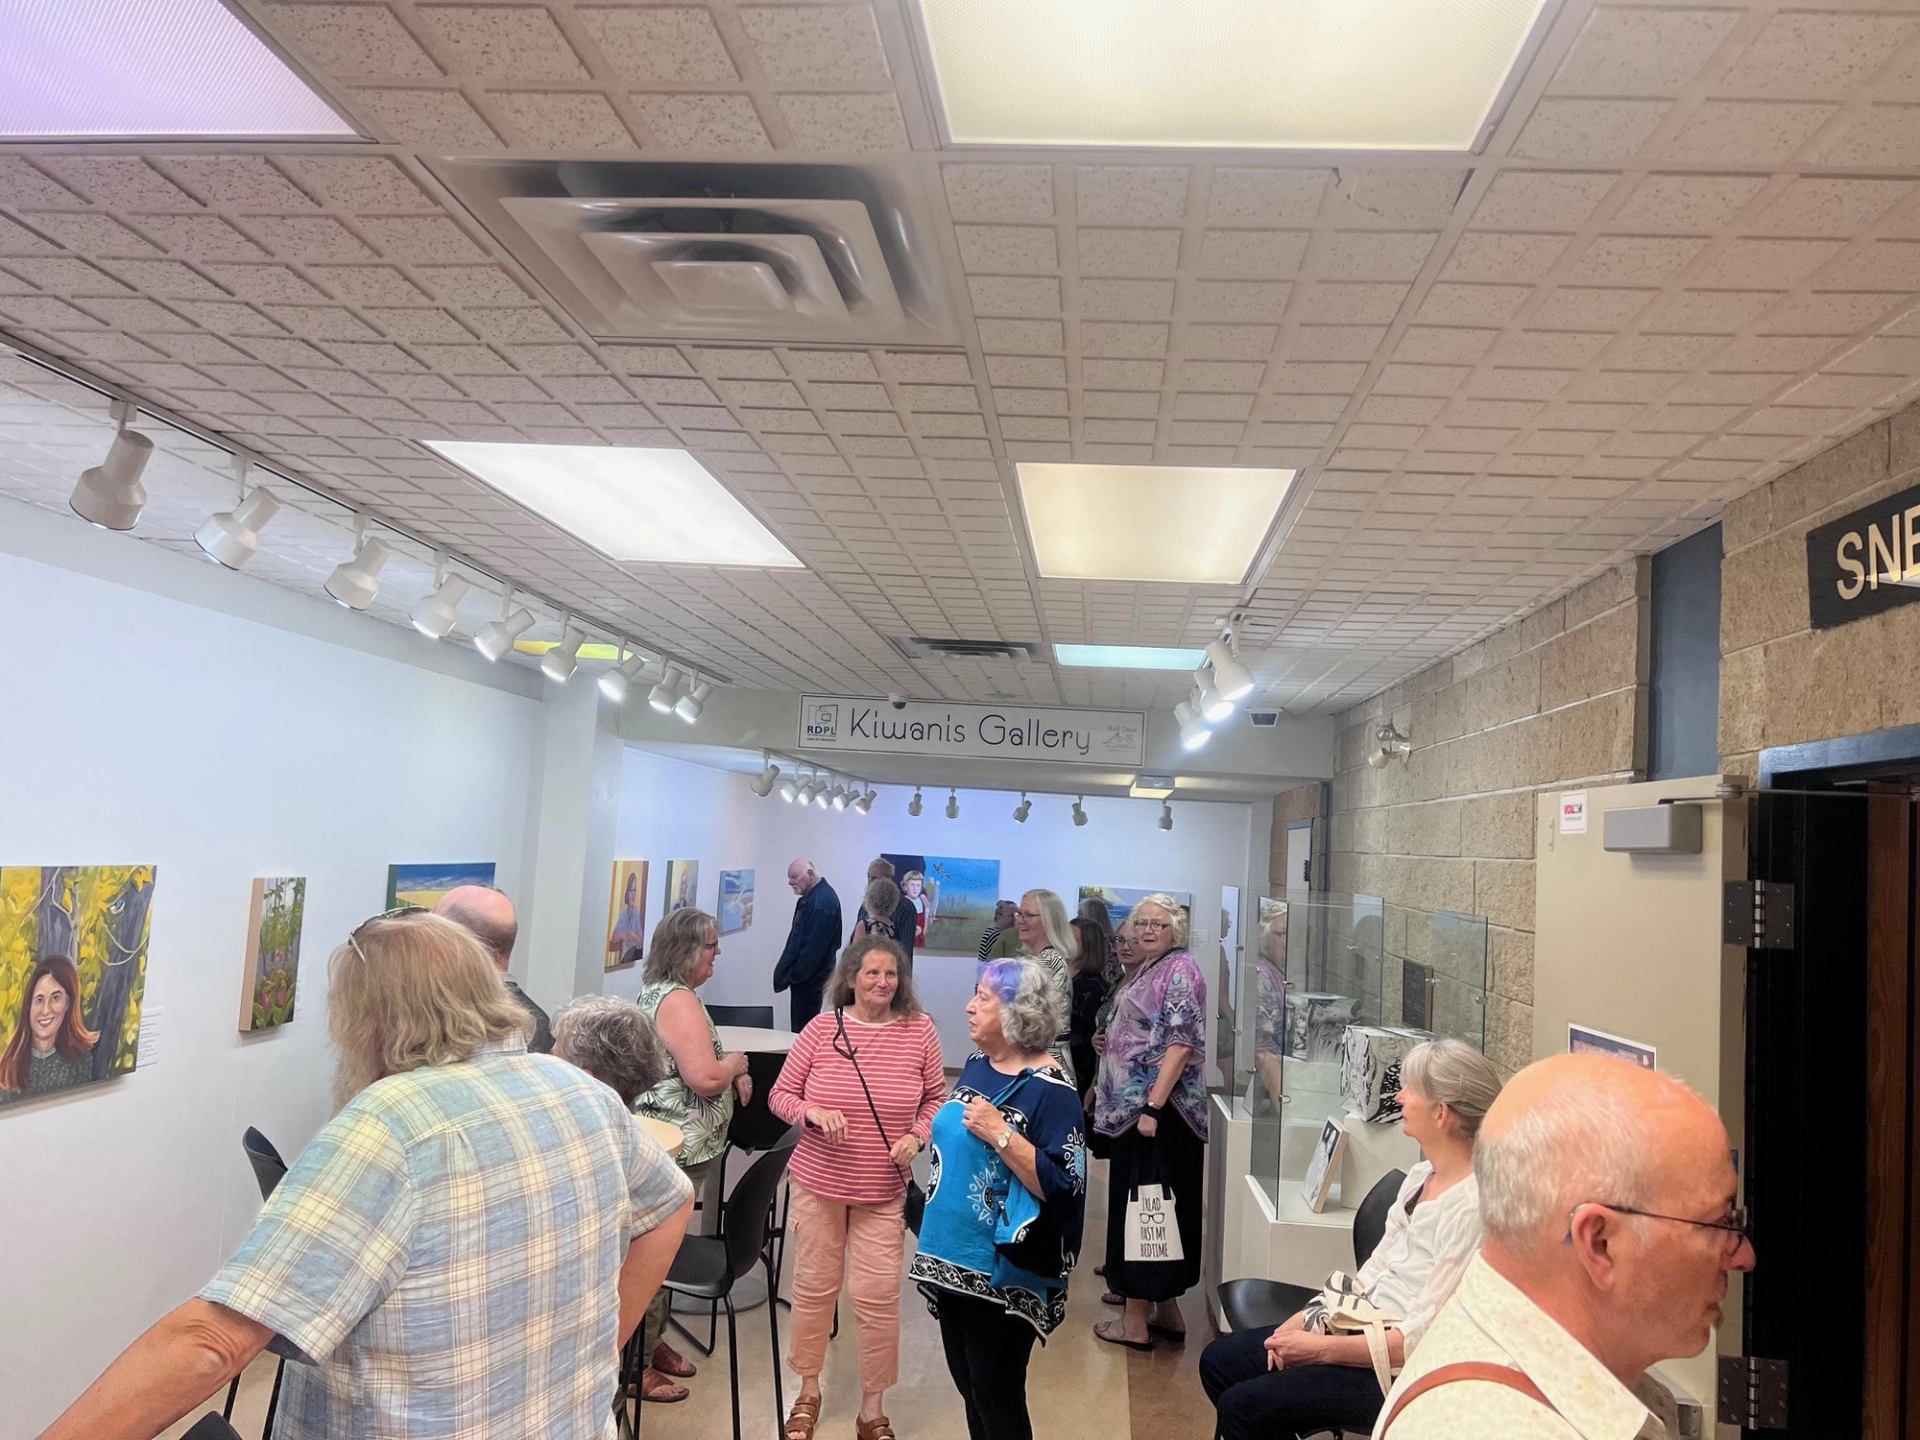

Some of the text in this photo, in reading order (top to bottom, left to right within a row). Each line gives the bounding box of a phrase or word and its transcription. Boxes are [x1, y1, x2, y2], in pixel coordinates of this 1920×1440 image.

[807, 725, 837, 735] RDPL
[850, 708, 1091, 755] Kiwanis Gallery
[1155, 1226, 1166, 1241] MY
[1140, 1243, 1168, 1258] BEDTIME
